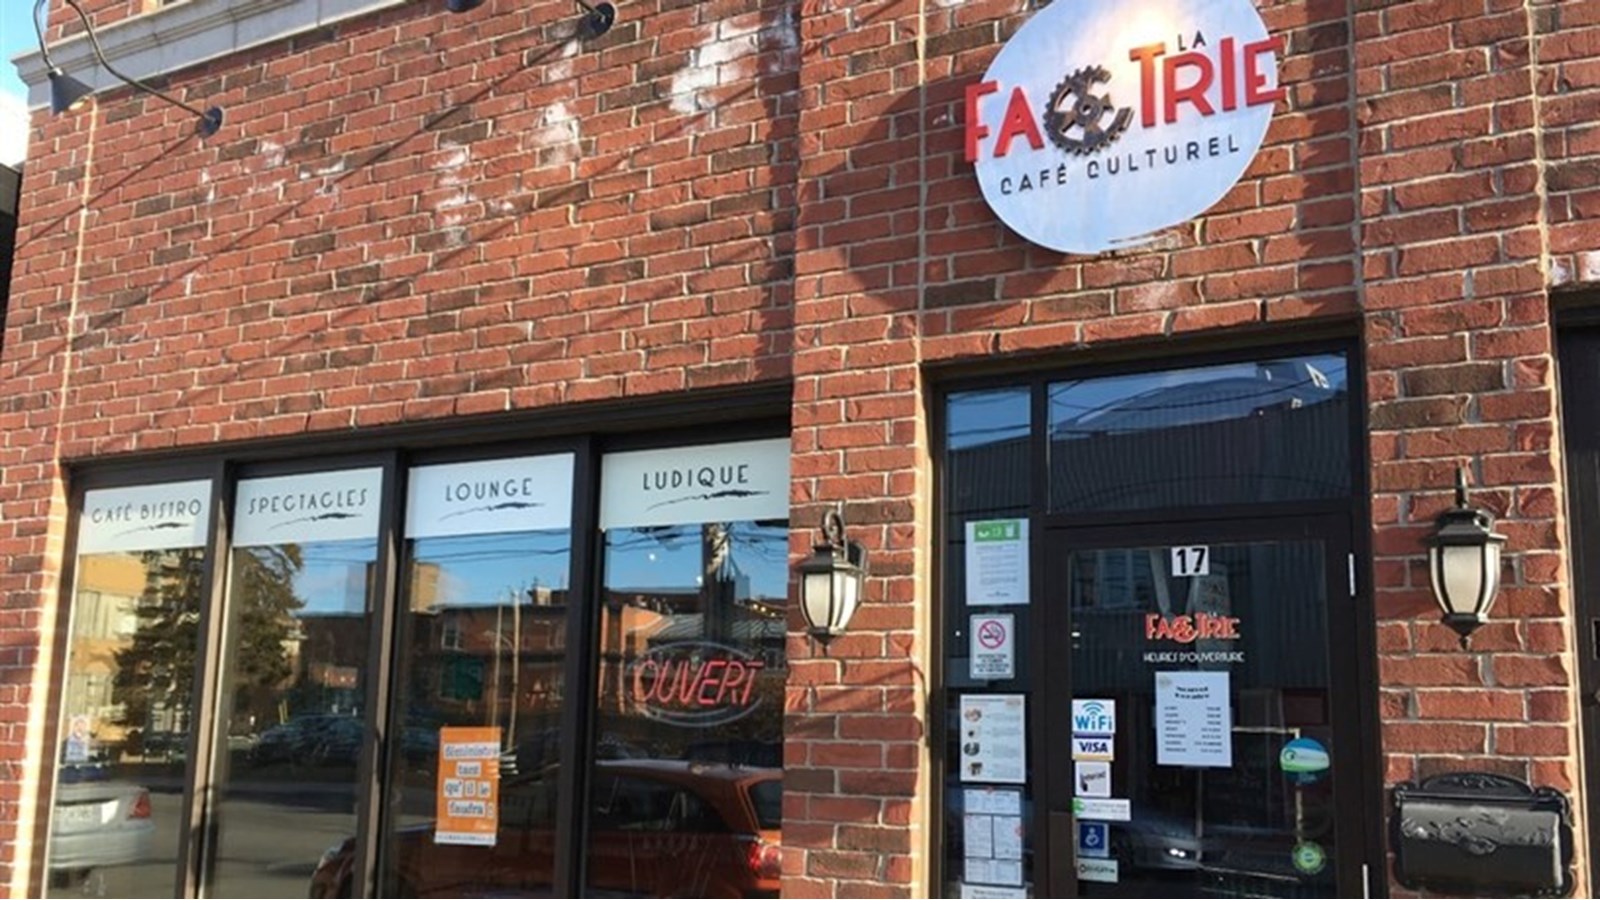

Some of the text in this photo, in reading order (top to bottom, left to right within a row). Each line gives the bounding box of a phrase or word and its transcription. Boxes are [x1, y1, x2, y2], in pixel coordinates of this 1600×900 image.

[1178, 30, 1206, 50] LA
[1000, 134, 1240, 195] CAFÉ CULTUREL
[445, 478, 533, 501] LOUNGE
[642, 464, 750, 491] LUDIQUE
[91, 499, 201, 524] CAFÉ BISTRO
[248, 489, 368, 515] SPECTACLES
[1176, 547, 1206, 574] 17
[1143, 652, 1178, 663] HEURES
[634, 660, 764, 705] OUVERT
[1075, 713, 1112, 731] WiFi
[1080, 741, 1108, 753] VISA
